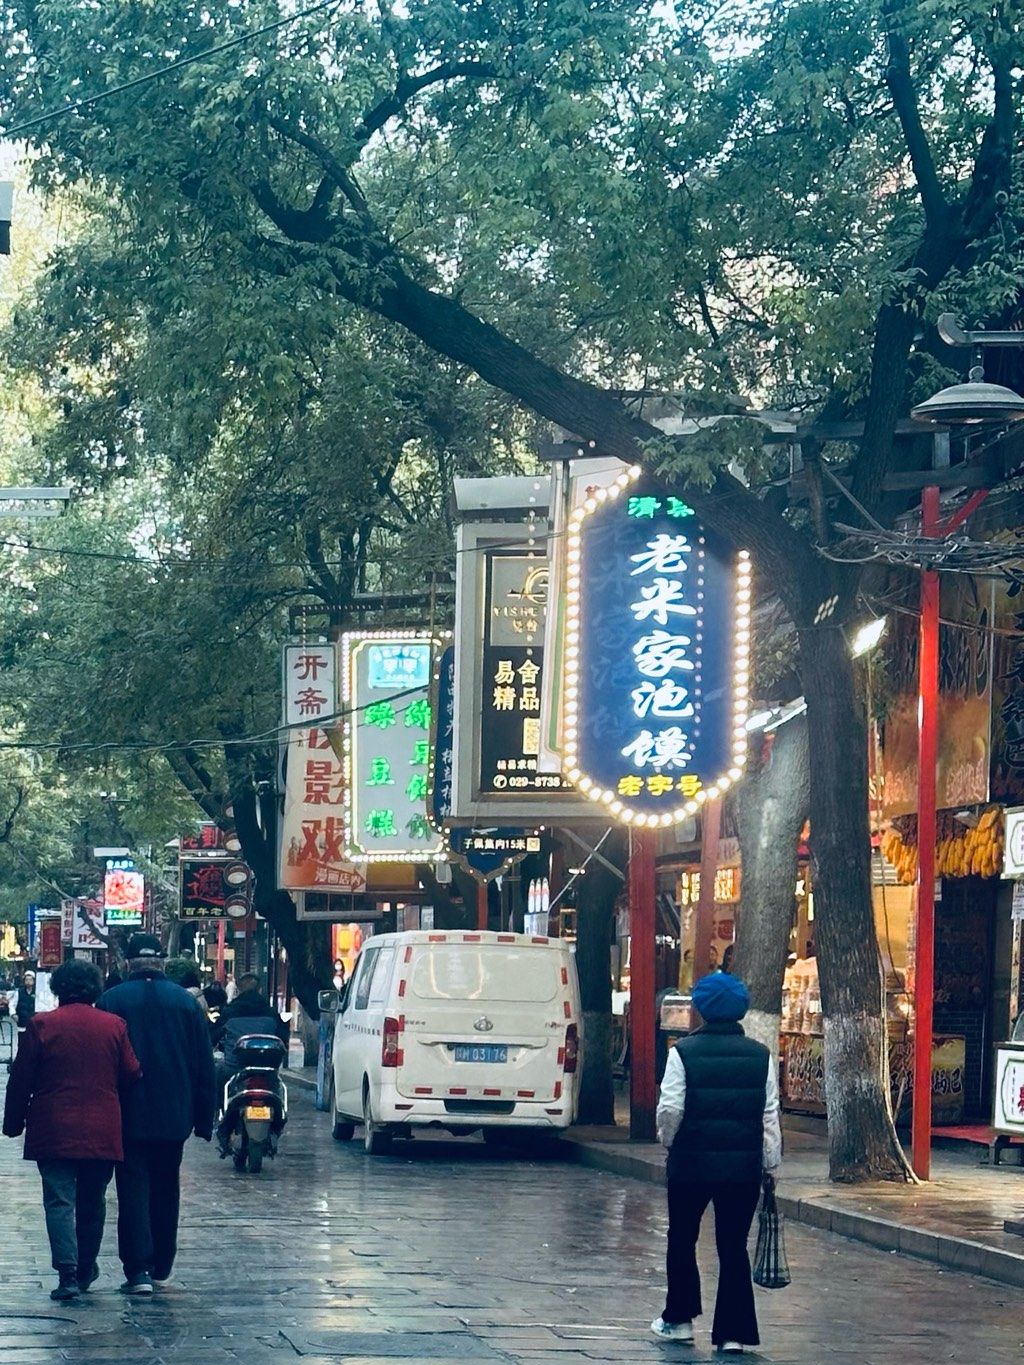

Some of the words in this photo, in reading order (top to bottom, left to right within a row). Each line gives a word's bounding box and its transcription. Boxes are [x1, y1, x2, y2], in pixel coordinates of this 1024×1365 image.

[621, 532, 696, 769] 老米家泡馍
[494, 659, 541, 684] 易舍
[293, 655, 328, 716] 开斋
[492, 687, 540, 711] 精品
[618, 774, 702, 797] 老字号
